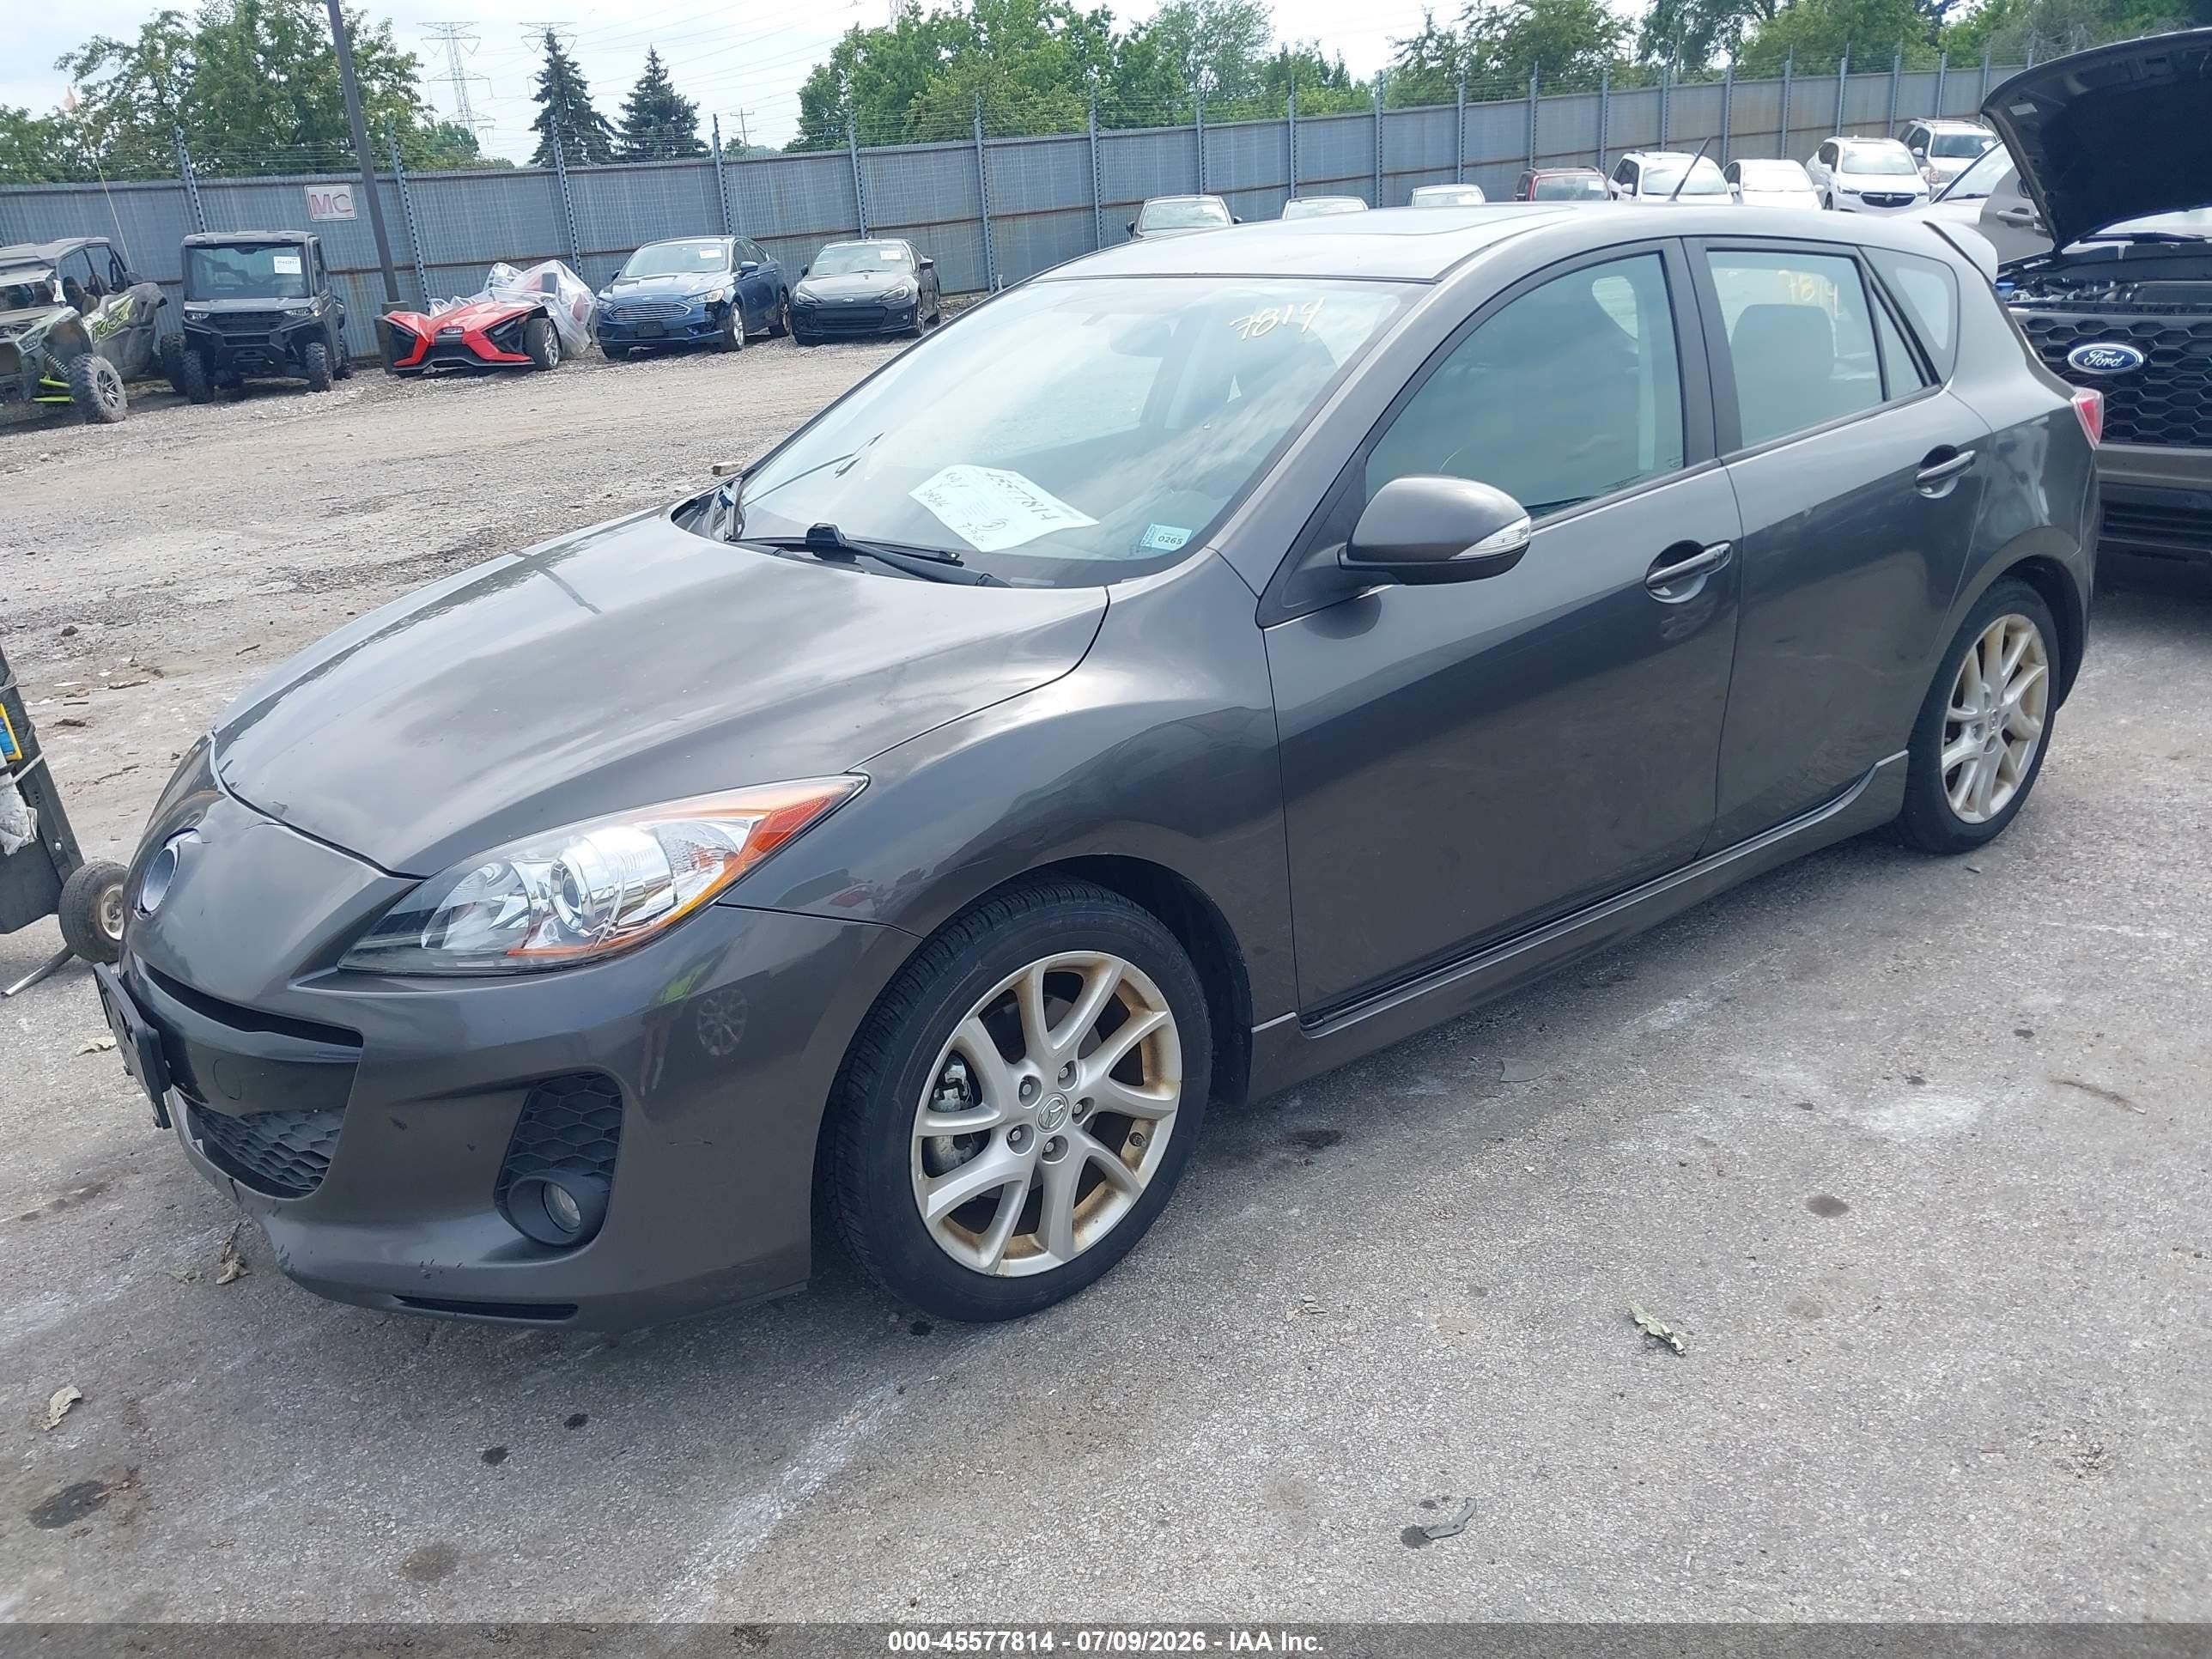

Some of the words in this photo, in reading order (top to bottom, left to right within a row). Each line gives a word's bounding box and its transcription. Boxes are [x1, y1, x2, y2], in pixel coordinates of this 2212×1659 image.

[310, 193, 353, 214] MC
[1229, 295, 1326, 340] 7814
[2083, 349, 2124, 368] Ford
[1158, 535, 1183, 545] 0265
